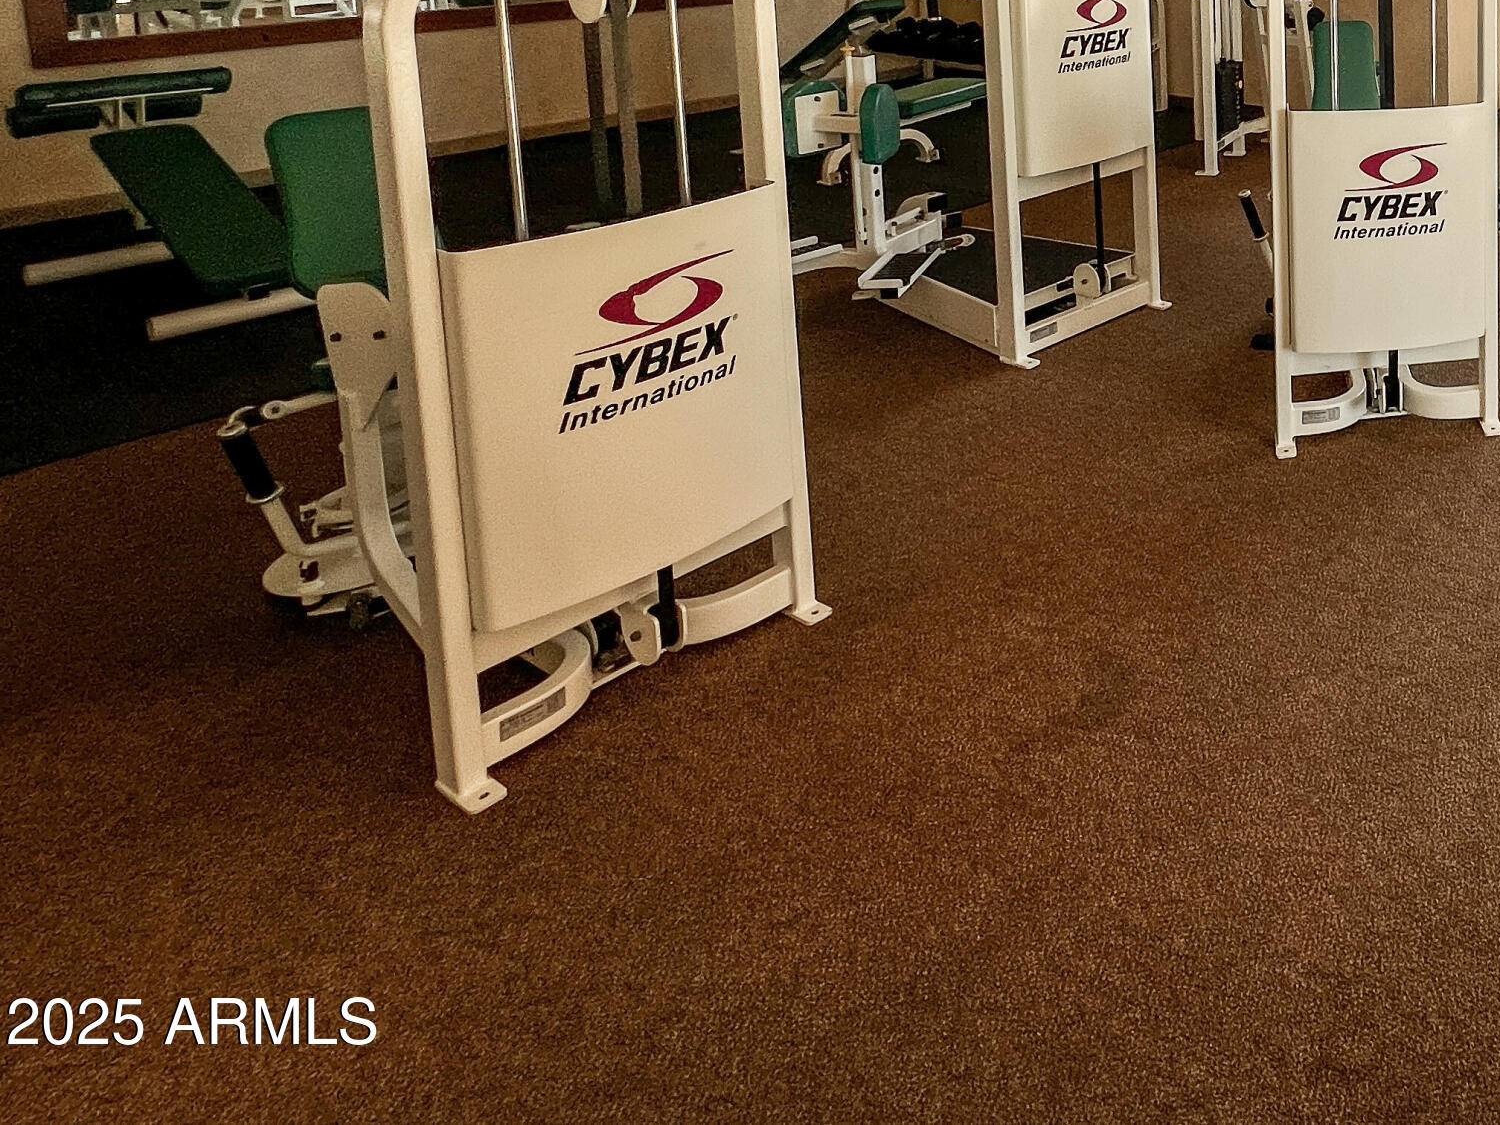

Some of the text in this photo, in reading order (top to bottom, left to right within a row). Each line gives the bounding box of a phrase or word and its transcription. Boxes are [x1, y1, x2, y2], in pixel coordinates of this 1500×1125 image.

[1060, 28, 1130, 59] CYBEX
[1058, 51, 1131, 74] International
[1336, 190, 1443, 223] CYBEX
[1333, 219, 1446, 240] International
[563, 315, 732, 407] CYBEX
[558, 355, 737, 435] International
